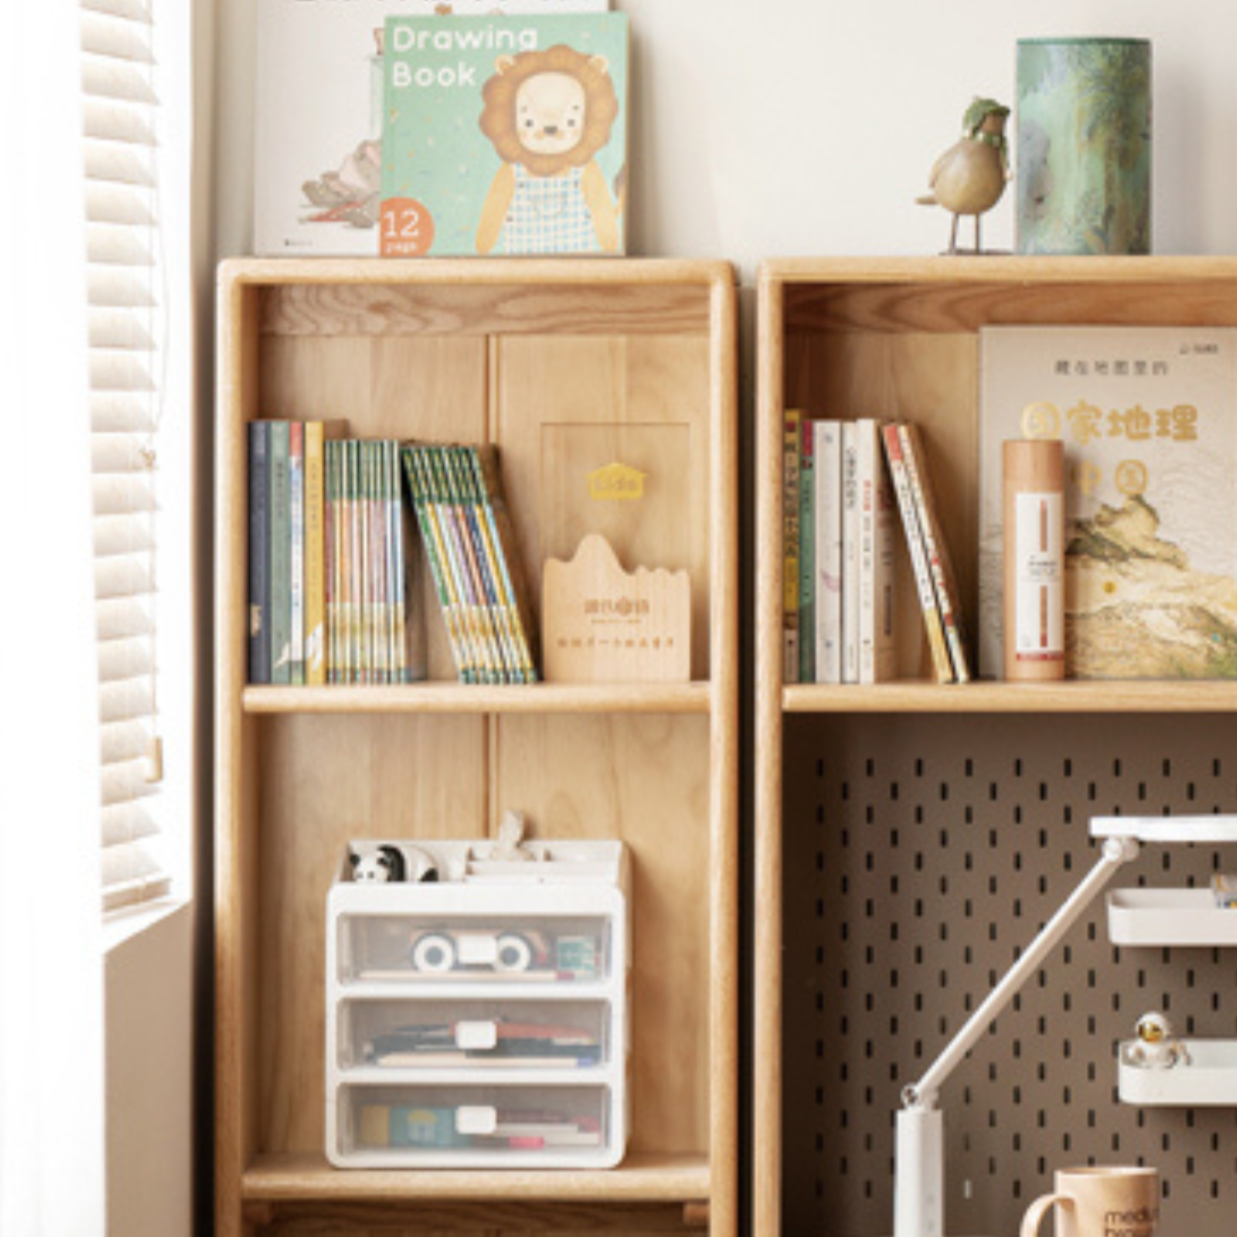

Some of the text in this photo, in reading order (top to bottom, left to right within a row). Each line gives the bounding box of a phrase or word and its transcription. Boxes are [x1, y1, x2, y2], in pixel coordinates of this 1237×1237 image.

[392, 26, 538, 52] Drawing
[392, 61, 476, 87] Book
[383, 210, 418, 236] 12
